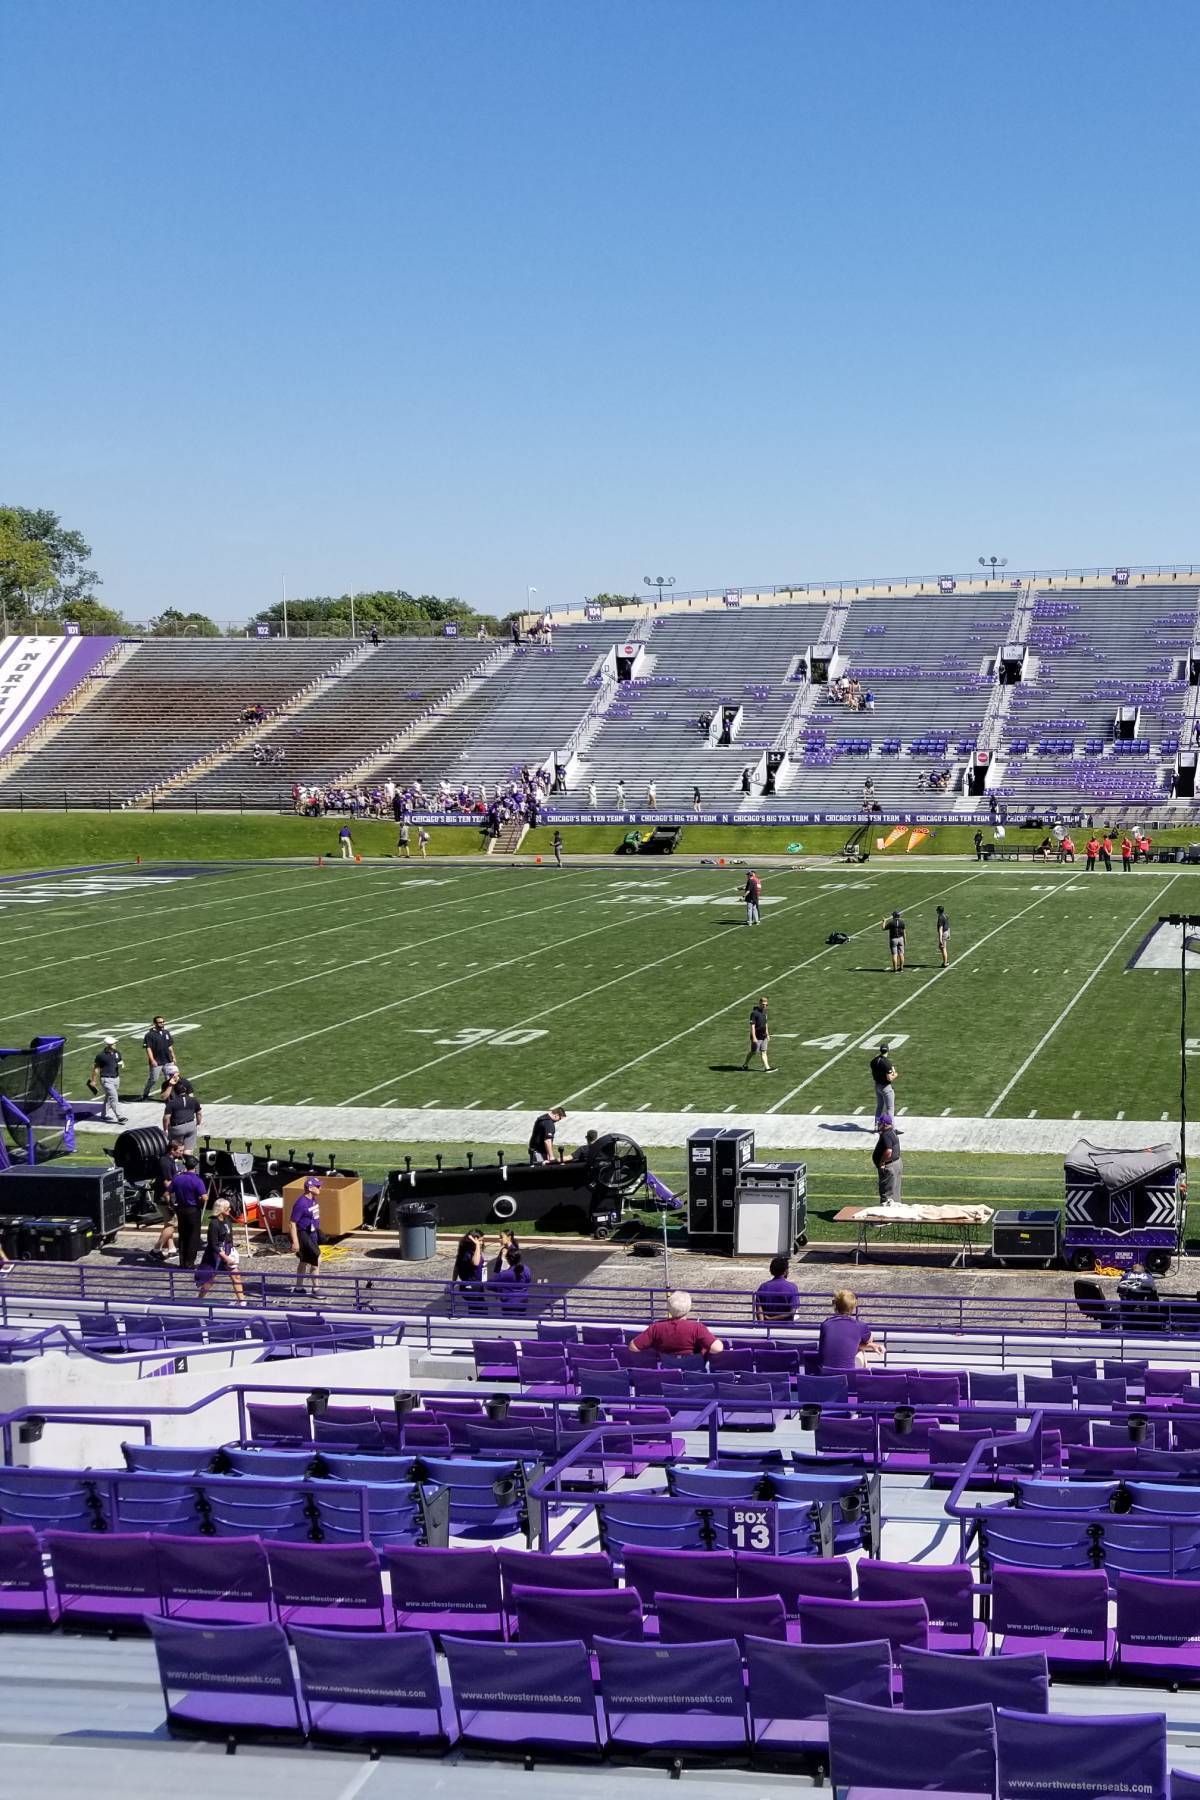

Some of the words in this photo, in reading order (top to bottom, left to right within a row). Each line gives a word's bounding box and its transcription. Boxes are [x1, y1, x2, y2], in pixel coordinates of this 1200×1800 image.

[589, 608, 601, 616] 104
[67, 626, 79, 635] 101
[257, 627, 269, 635] 102
[446, 626, 456, 635] 103
[432, 1028, 549, 1045] 30
[801, 1033, 911, 1050] 40
[1109, 1190, 1132, 1224] N
[735, 1512, 767, 1524] BOX
[732, 1525, 770, 1549] 13
[167, 1670, 282, 1686] www.northwesternseats.com
[308, 1683, 427, 1700] www.northwesternseats.com
[461, 1691, 582, 1704] www.northwesternseats.com
[611, 1694, 734, 1704] www.northwesternseats.com
[1008, 1778, 1154, 1794] www.northwesternseats.com
